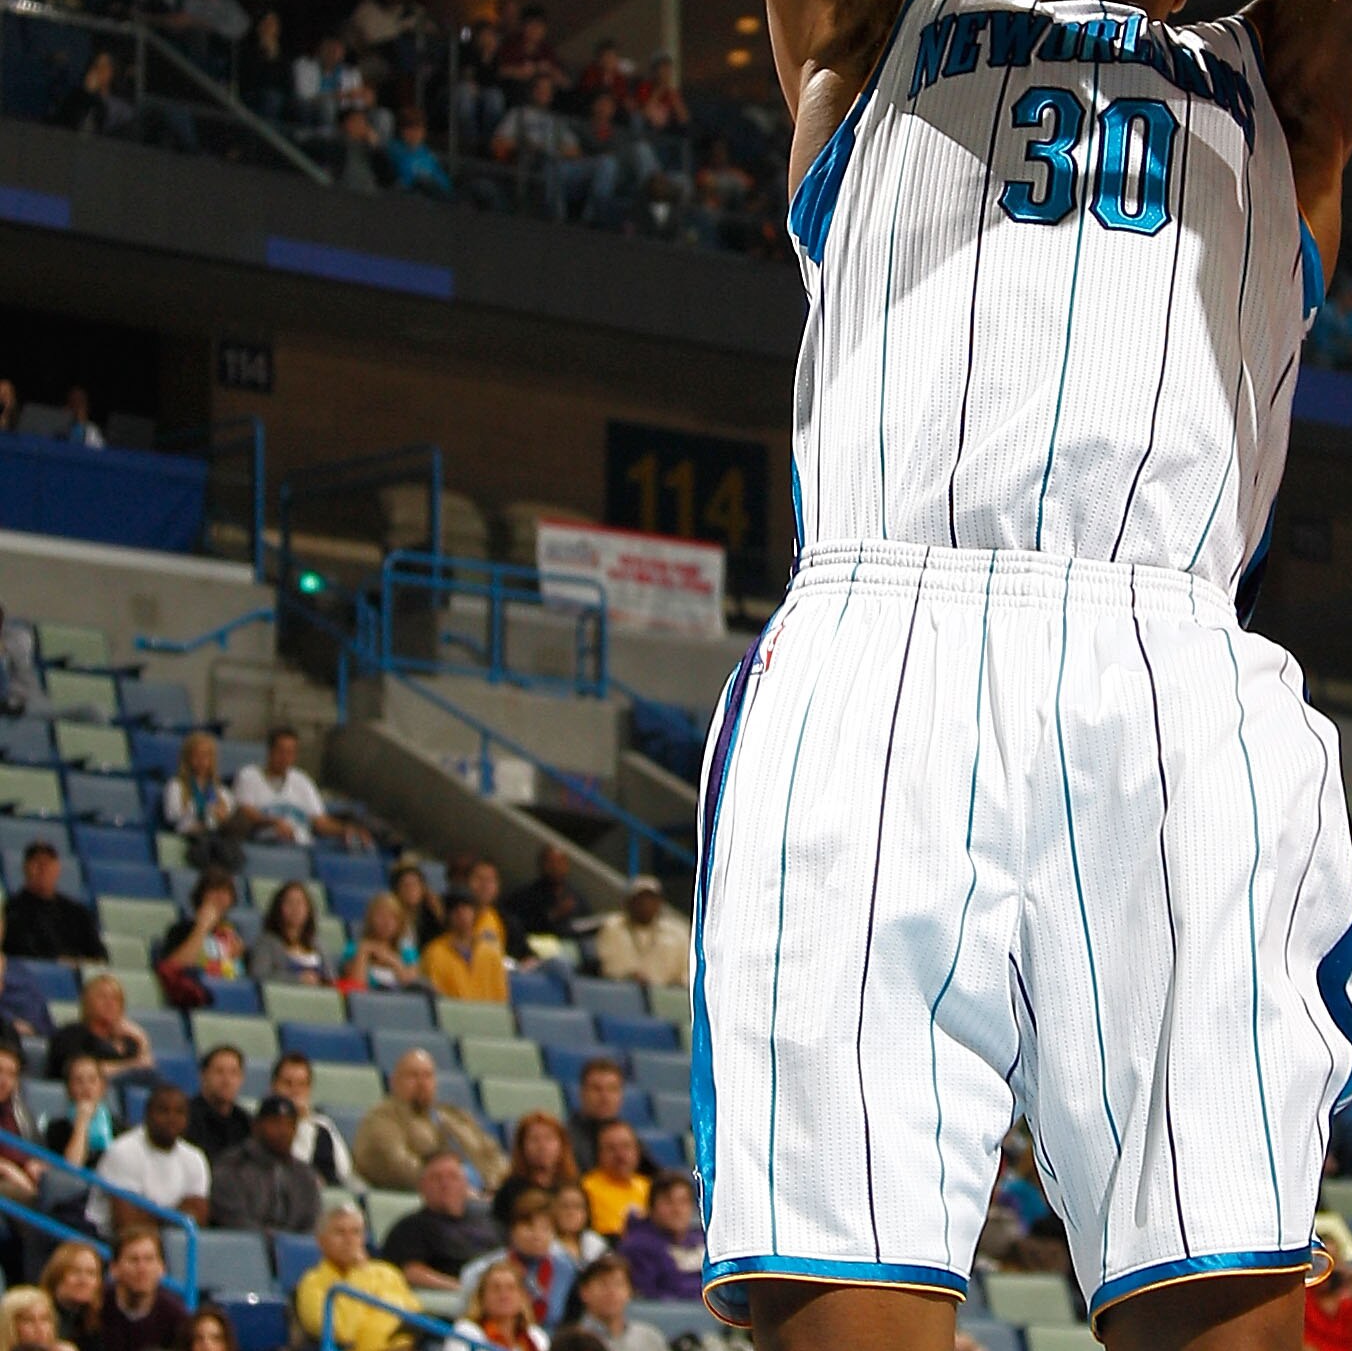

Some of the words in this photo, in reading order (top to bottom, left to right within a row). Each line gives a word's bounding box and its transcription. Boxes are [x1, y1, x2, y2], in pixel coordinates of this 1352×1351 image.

[907, 9, 1052, 100] NEW
[997, 85, 1180, 237] 30
[626, 451, 751, 549] 114
